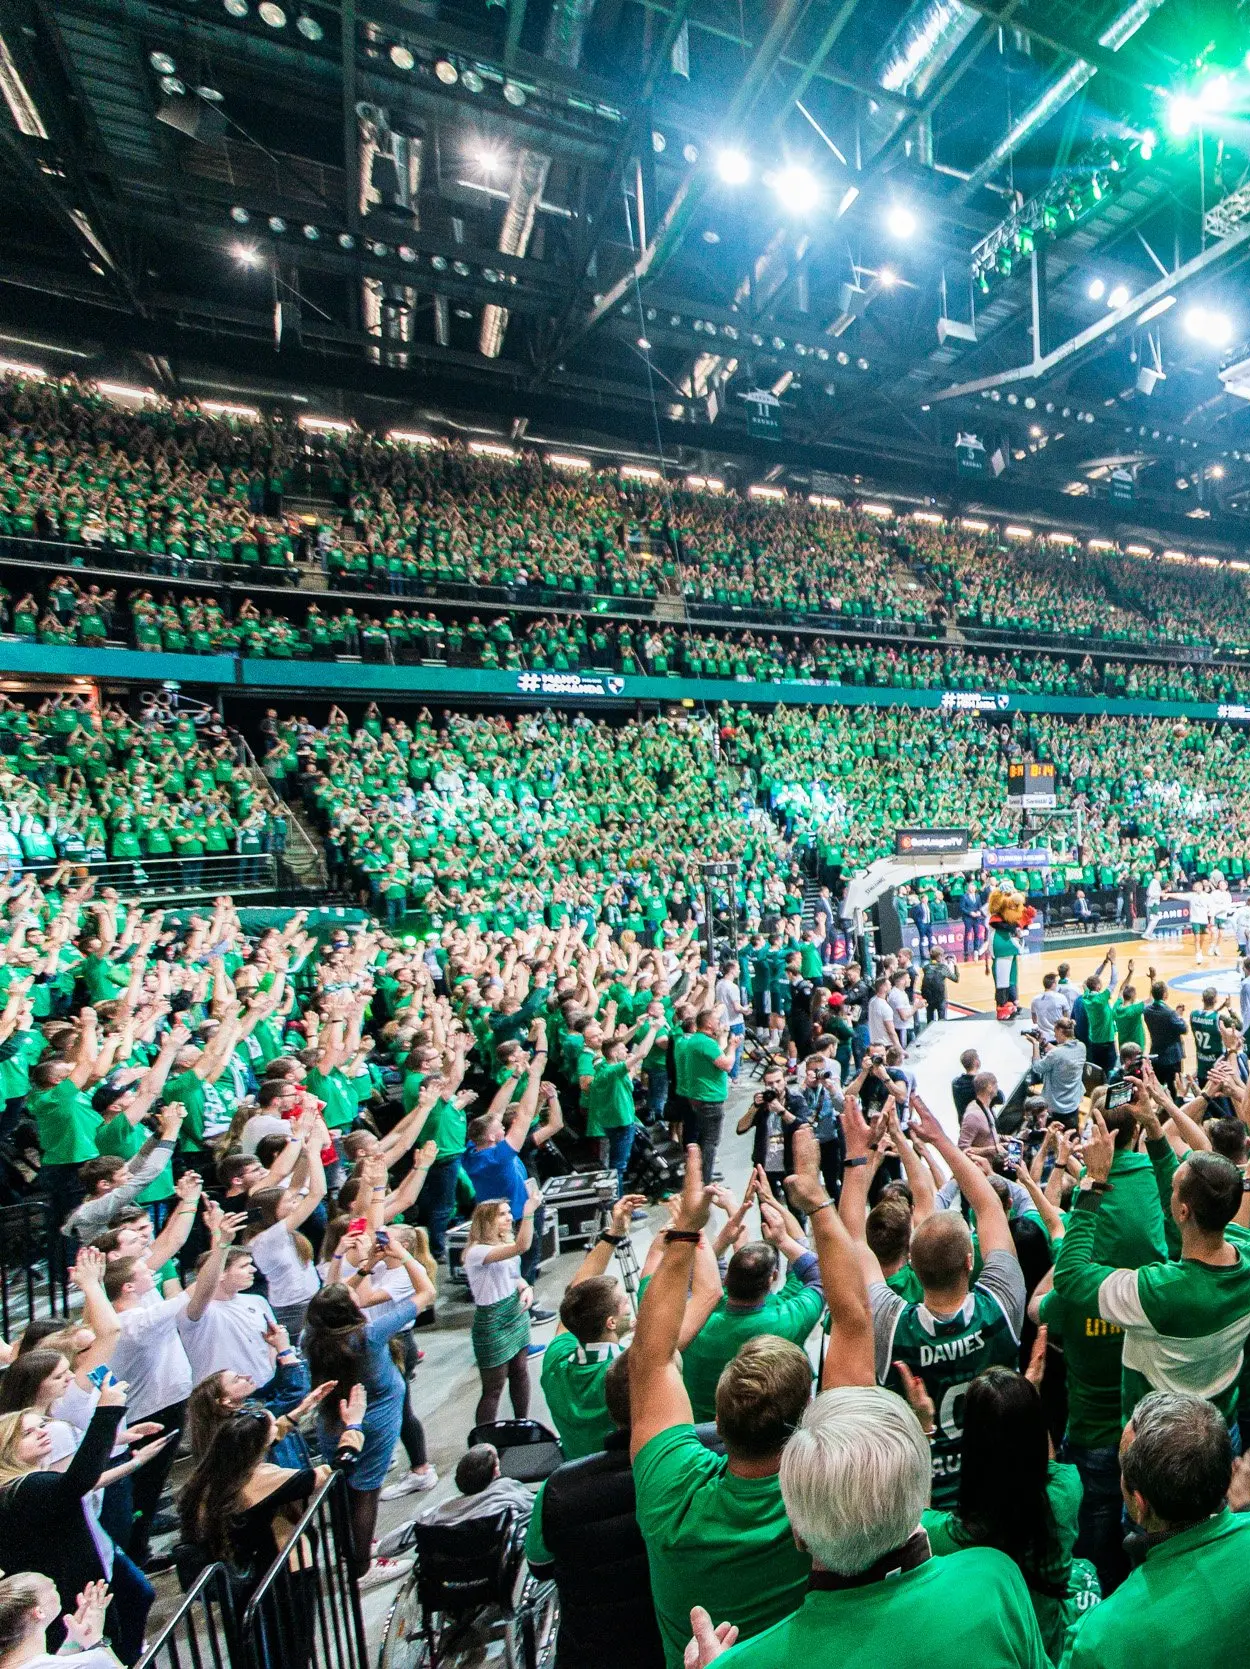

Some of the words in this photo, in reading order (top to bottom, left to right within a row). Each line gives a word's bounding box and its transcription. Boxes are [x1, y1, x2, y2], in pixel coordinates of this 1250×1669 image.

[758, 403, 770, 417] 11
[1195, 1031, 1211, 1049] 92
[920, 1330, 985, 1367] DAVIES
